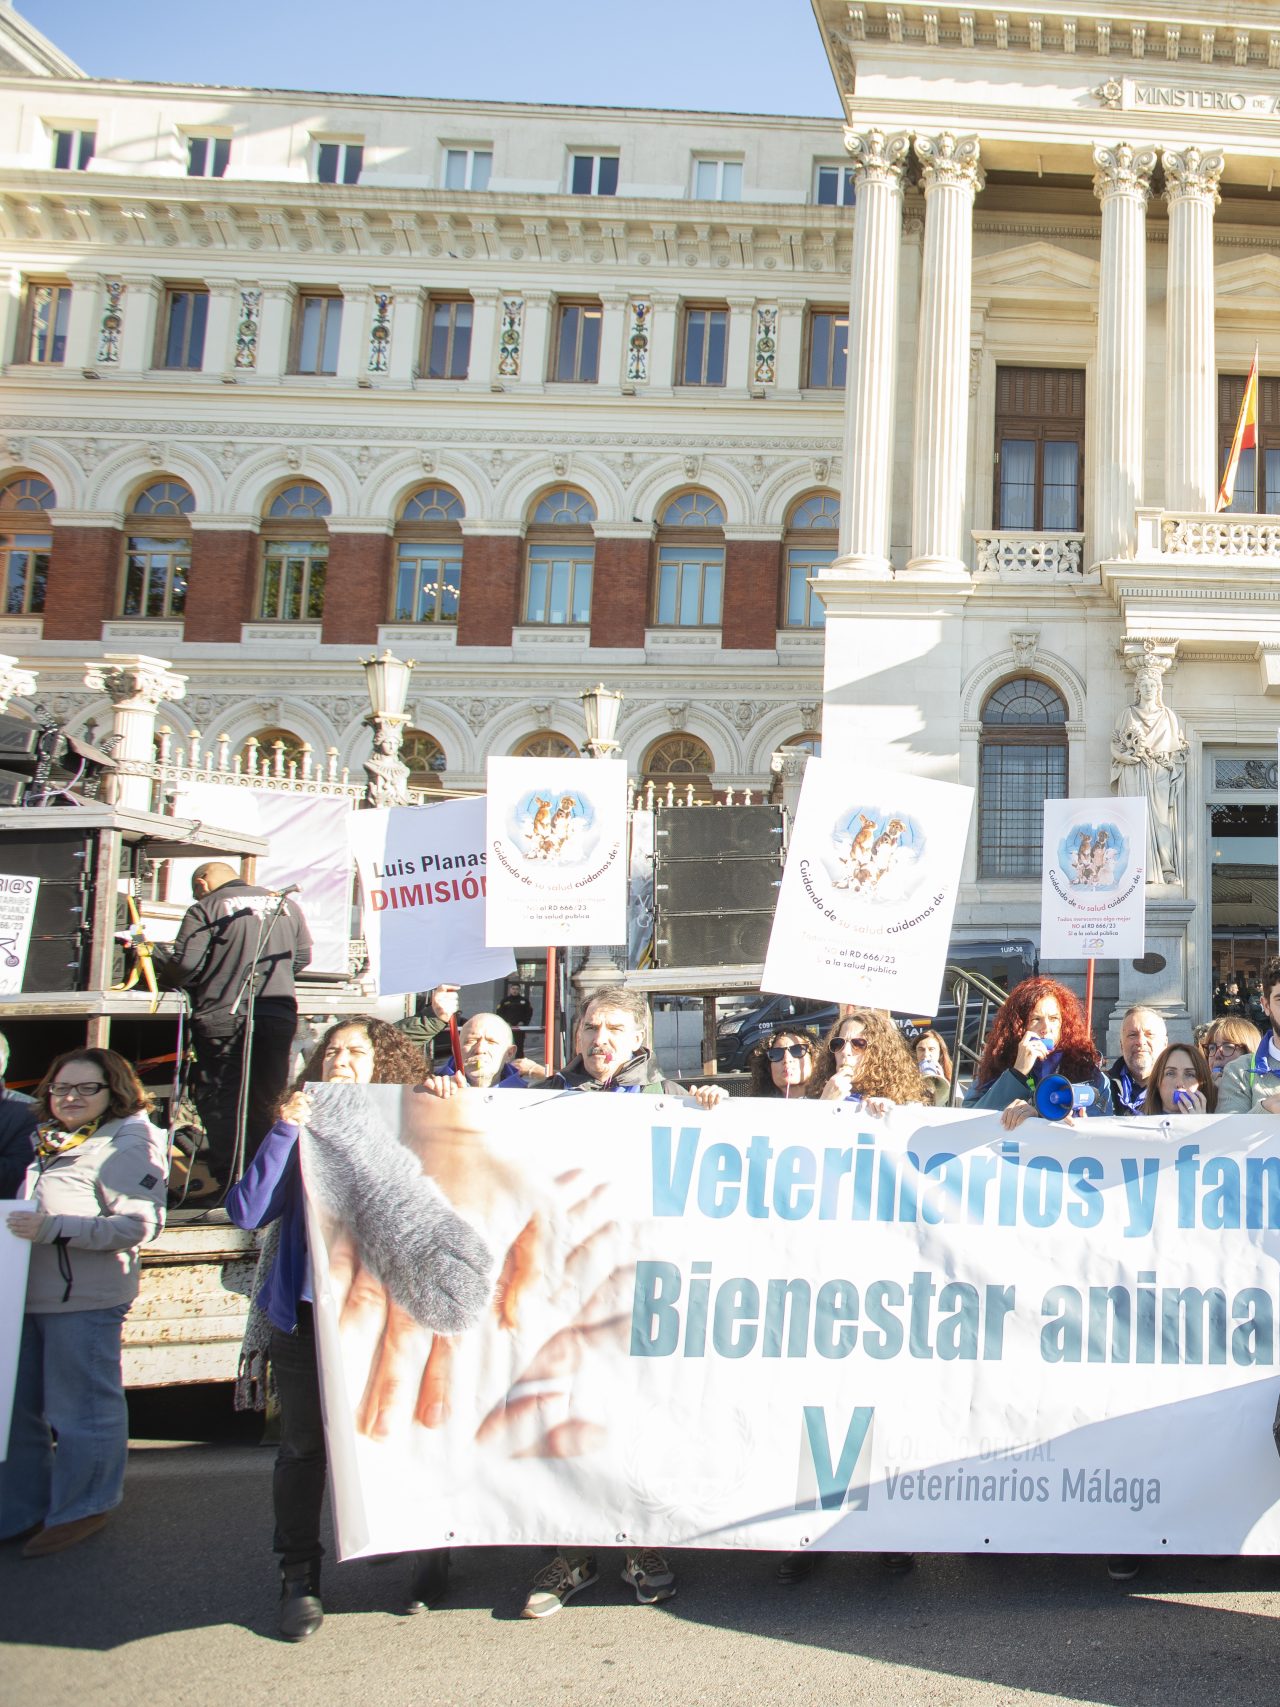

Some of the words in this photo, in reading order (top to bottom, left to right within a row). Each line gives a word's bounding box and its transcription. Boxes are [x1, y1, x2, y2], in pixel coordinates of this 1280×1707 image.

[1135, 87, 1246, 111] MINISTERIO
[1252, 99, 1265, 109] DE
[373, 856, 415, 879] Luis
[421, 852, 487, 873] Planas
[493, 840, 520, 879] Cuidando
[575, 860, 611, 889] cuidamos
[800, 859, 824, 910] Cuidando
[824, 909, 836, 922] de
[886, 905, 935, 935] cuidamos
[934, 893, 945, 906] de
[1048, 869, 1068, 901] Cuidando
[1068, 898, 1077, 908] de
[1087, 903, 1107, 912] salud
[1107, 884, 1136, 909] cuidamos
[1133, 874, 1141, 885] de
[843, 961, 866, 970] salud
[850, 950, 861, 959] RD
[863, 952, 896, 964] 666/23
[651, 1126, 1104, 1231] Veterinarios
[1123, 1157, 1160, 1237] y
[630, 1260, 1016, 1359] Bienestar
[979, 1436, 1056, 1463] OFICIAL
[885, 1466, 1050, 1502] Veterinarios
[1062, 1467, 1162, 1512] Málaga
